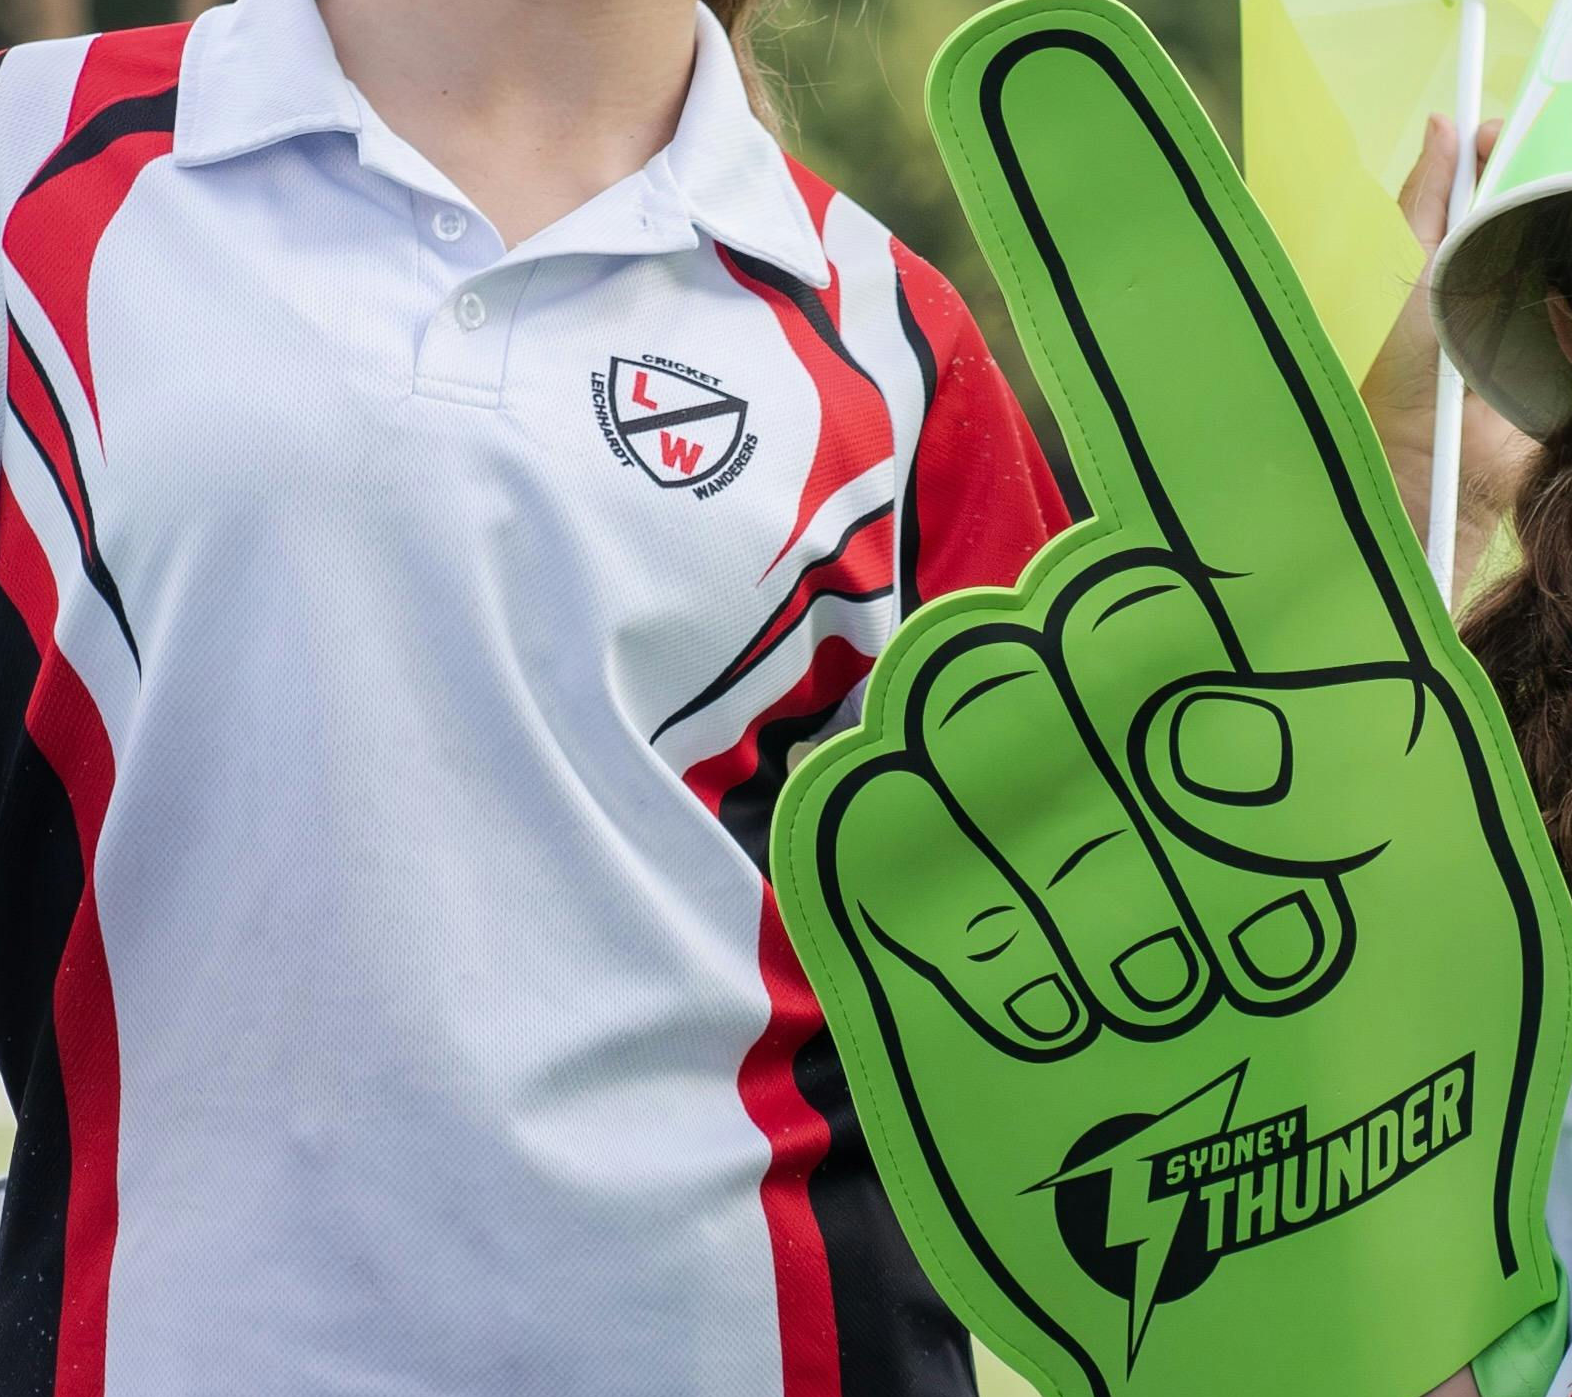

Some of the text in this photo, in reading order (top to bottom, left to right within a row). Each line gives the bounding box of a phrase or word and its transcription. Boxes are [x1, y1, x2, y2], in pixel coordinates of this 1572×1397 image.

[632, 370, 658, 411] L
[641, 354, 722, 387] CRICKET
[591, 371, 635, 468] LEICHHARDT
[660, 429, 704, 476] W
[692, 433, 758, 501] WANDERERS
[1165, 1118, 1298, 1187] SYDNEY
[1199, 1066, 1466, 1253] THUNDER
